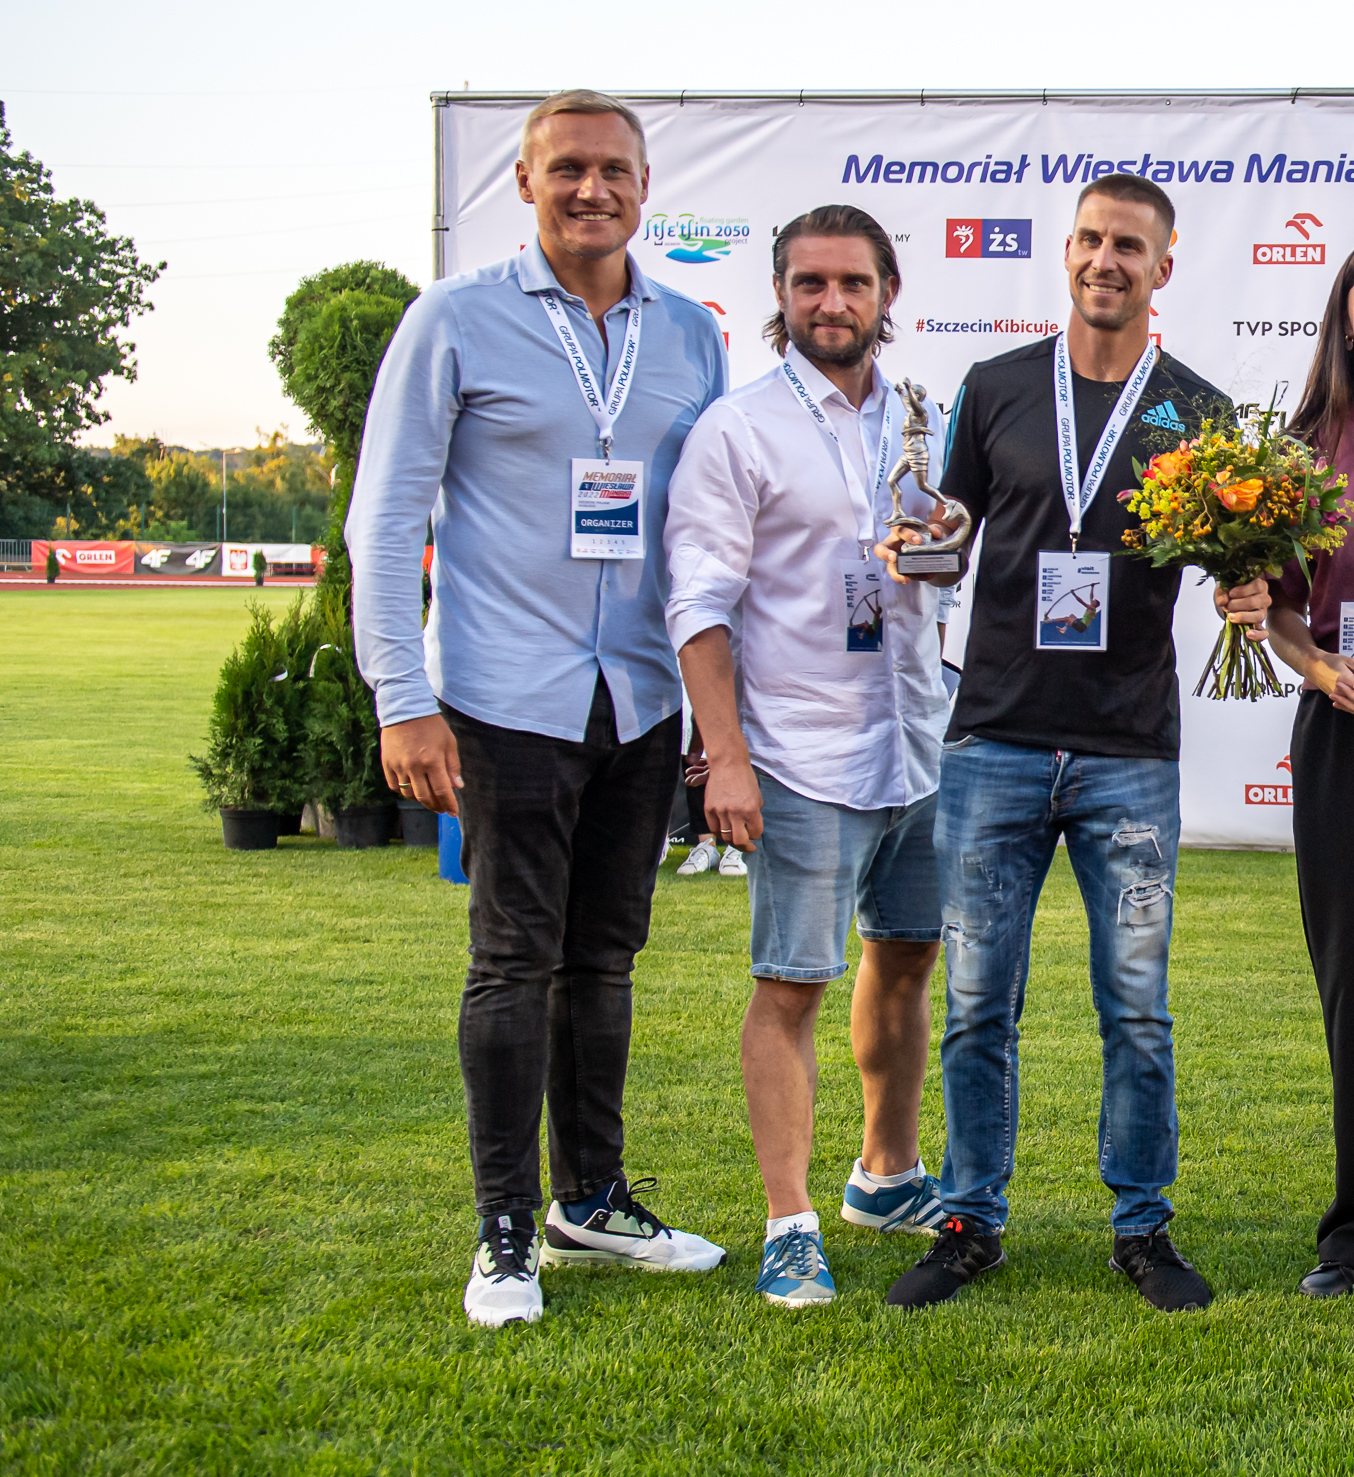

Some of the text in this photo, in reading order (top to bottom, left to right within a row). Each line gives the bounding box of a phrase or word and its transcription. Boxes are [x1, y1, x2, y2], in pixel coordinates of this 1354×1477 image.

[841, 153, 1031, 184] Memoriał
[1040, 153, 1235, 184] Wiesława
[714, 225, 750, 238] 2050
[724, 237, 748, 245] project
[894, 233, 911, 243] MY
[1256, 247, 1322, 262] ORLEN
[915, 318, 1059, 337] #SzczecinKibicuje
[1233, 321, 1321, 336] TVP SPO
[559, 325, 600, 407] GRUPA POLMOTOR
[608, 386, 625, 416] GRUPA
[619, 339, 636, 387] POLMOTOR
[1057, 355, 1068, 402] POLMOTOR
[1118, 347, 1155, 417] GRUPA POLMOTOR
[1141, 412, 1186, 433] adidas
[1060, 417, 1075, 500] GRUPA POLMOTOR
[1080, 428, 1118, 509] GRUPA POLMOTOR
[580, 518, 633, 528] ORGANIZER
[78, 552, 113, 562] ORLEN
[141, 549, 172, 568] 4F
[185, 549, 216, 569] 4F
